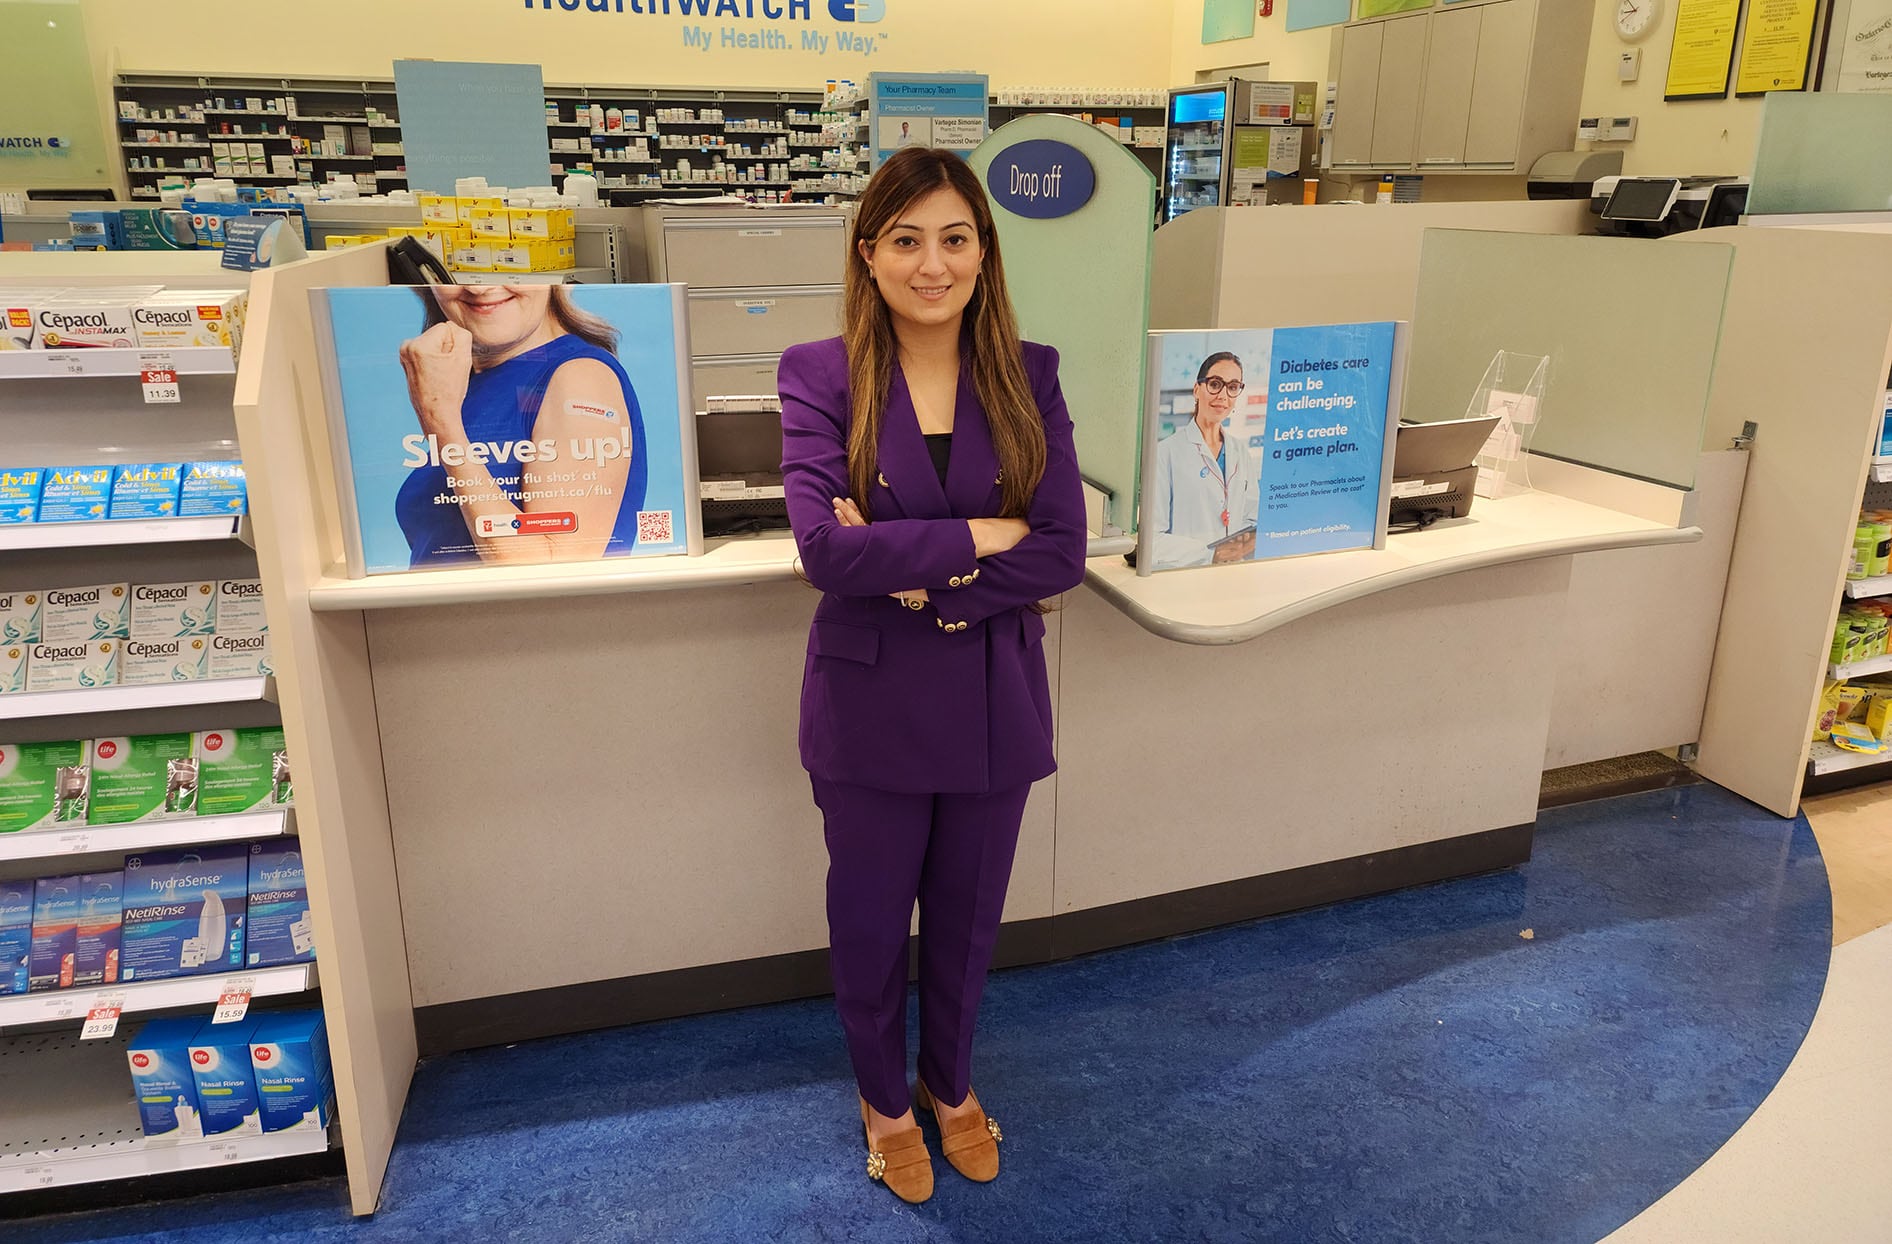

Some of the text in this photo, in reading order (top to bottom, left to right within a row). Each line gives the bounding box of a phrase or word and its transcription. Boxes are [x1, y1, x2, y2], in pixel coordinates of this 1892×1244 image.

[683, 26, 712, 52] My
[720, 27, 792, 50] Health.
[801, 30, 829, 55] My
[885, 85, 956, 95] Your Pharmacy Team
[1010, 164, 1062, 202] Drop off
[1280, 358, 1369, 374] Diabetes care
[148, 372, 172, 382] Sale
[1278, 377, 1324, 393] can be
[1276, 393, 1357, 411] challenging.
[1274, 424, 1348, 441] Let's create
[402, 427, 632, 468] Sleeves up!
[1272, 440, 1359, 461] a game plan.
[0, 472, 38, 486] dvil
[46, 470, 108, 484] Advil
[116, 467, 176, 482] Advil
[446, 475, 482, 488] Book
[488, 474, 520, 490] your
[523, 472, 542, 484] flu
[582, 471, 597, 481] at
[1270, 484, 1288, 492] Speak
[1310, 478, 1346, 487] Pharmacists
[434, 484, 612, 505] shoppersdrugmart.ca/flu
[1274, 491, 1309, 500] Medication
[1300, 527, 1322, 537] patient
[222, 582, 262, 597] Cēpac
[261, 867, 304, 881] hydraSen
[151, 874, 221, 892] hydraSense
[82, 896, 120, 906] hydraSense
[251, 890, 296, 901] NetiRinse
[38, 900, 76, 909] hydraSense
[126, 904, 186, 919] NetiRinse
[224, 995, 245, 1004] Sale
[93, 1010, 115, 1019] Sale
[220, 1010, 243, 1018] 15.59
[88, 1024, 113, 1033] 23.99
